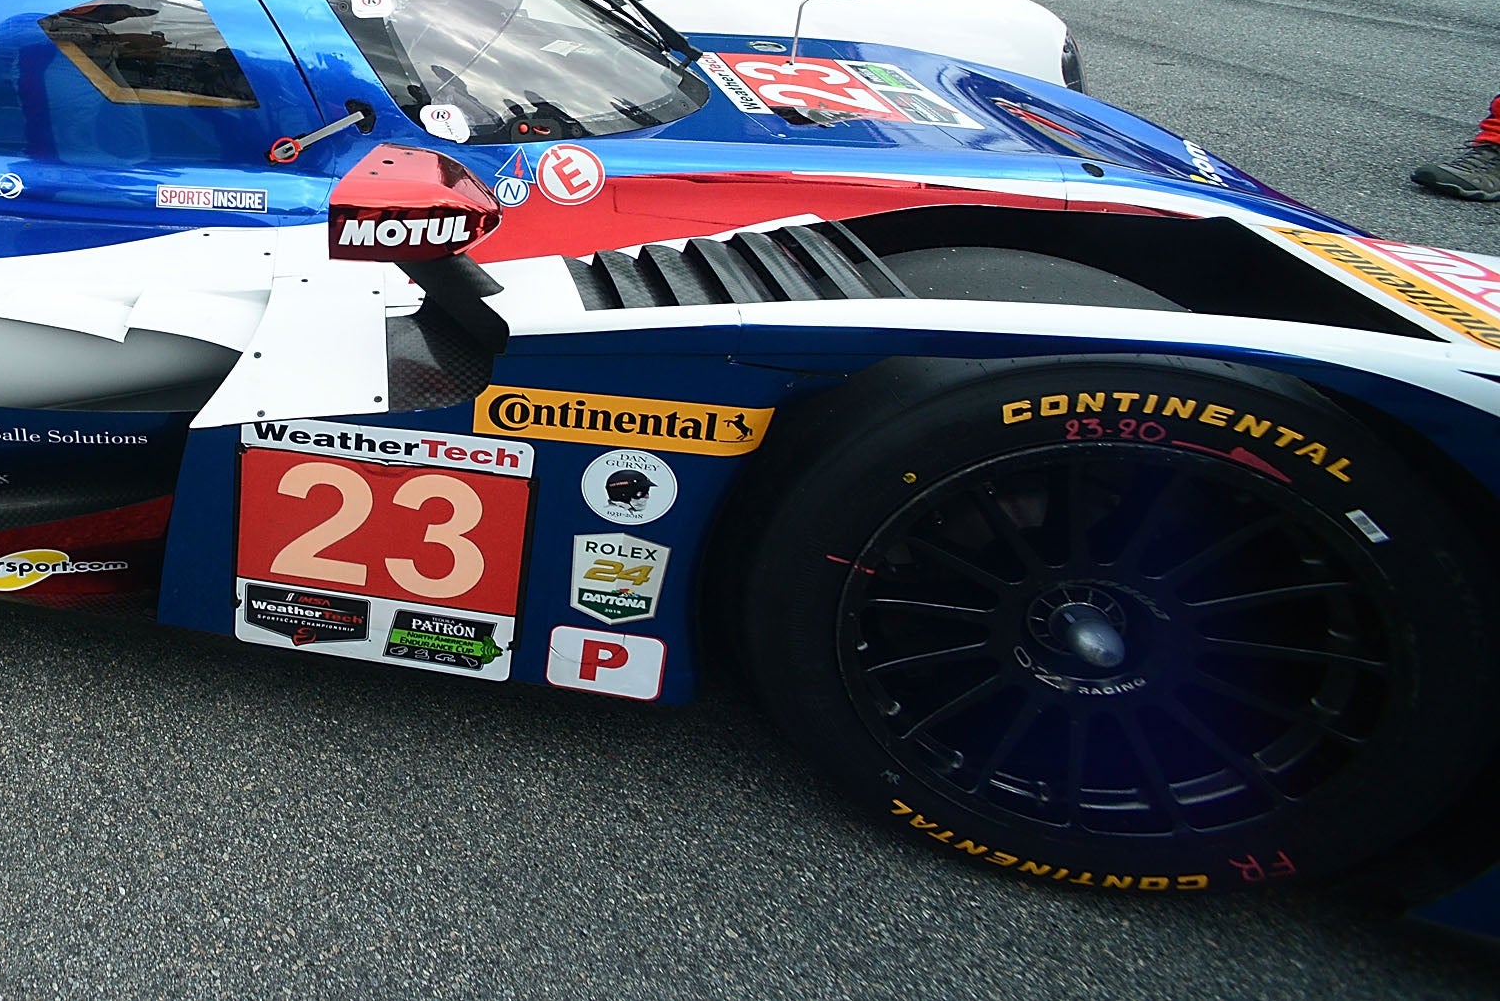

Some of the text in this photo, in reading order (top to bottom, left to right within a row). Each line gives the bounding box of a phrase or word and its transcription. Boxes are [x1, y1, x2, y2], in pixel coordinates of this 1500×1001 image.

[734, 60, 893, 114] 23
[551, 155, 592, 196] E
[159, 189, 264, 210] SPORTS INSURE
[503, 182, 522, 201] N
[338, 215, 471, 246] MOTUL
[1300, 241, 1500, 350] ntinental
[488, 392, 719, 443] Continental
[1065, 419, 1168, 442] 23-20
[48, 429, 148, 446] Solutions
[254, 421, 522, 469] WeatherTech
[1001, 390, 1353, 484] CONTINENTAL
[605, 459, 660, 471] GURNEY
[620, 454, 648, 463] DAN
[268, 462, 485, 599] 23
[585, 540, 658, 561] ROLEX
[583, 558, 654, 586] 24
[251, 599, 364, 625] WeatherTech
[581, 592, 647, 610] DAYTONA
[411, 617, 477, 640] PATRÓN
[579, 639, 630, 682] P
[1077, 677, 1148, 696] RACING
[890, 799, 1210, 893] CONTINENTAL
